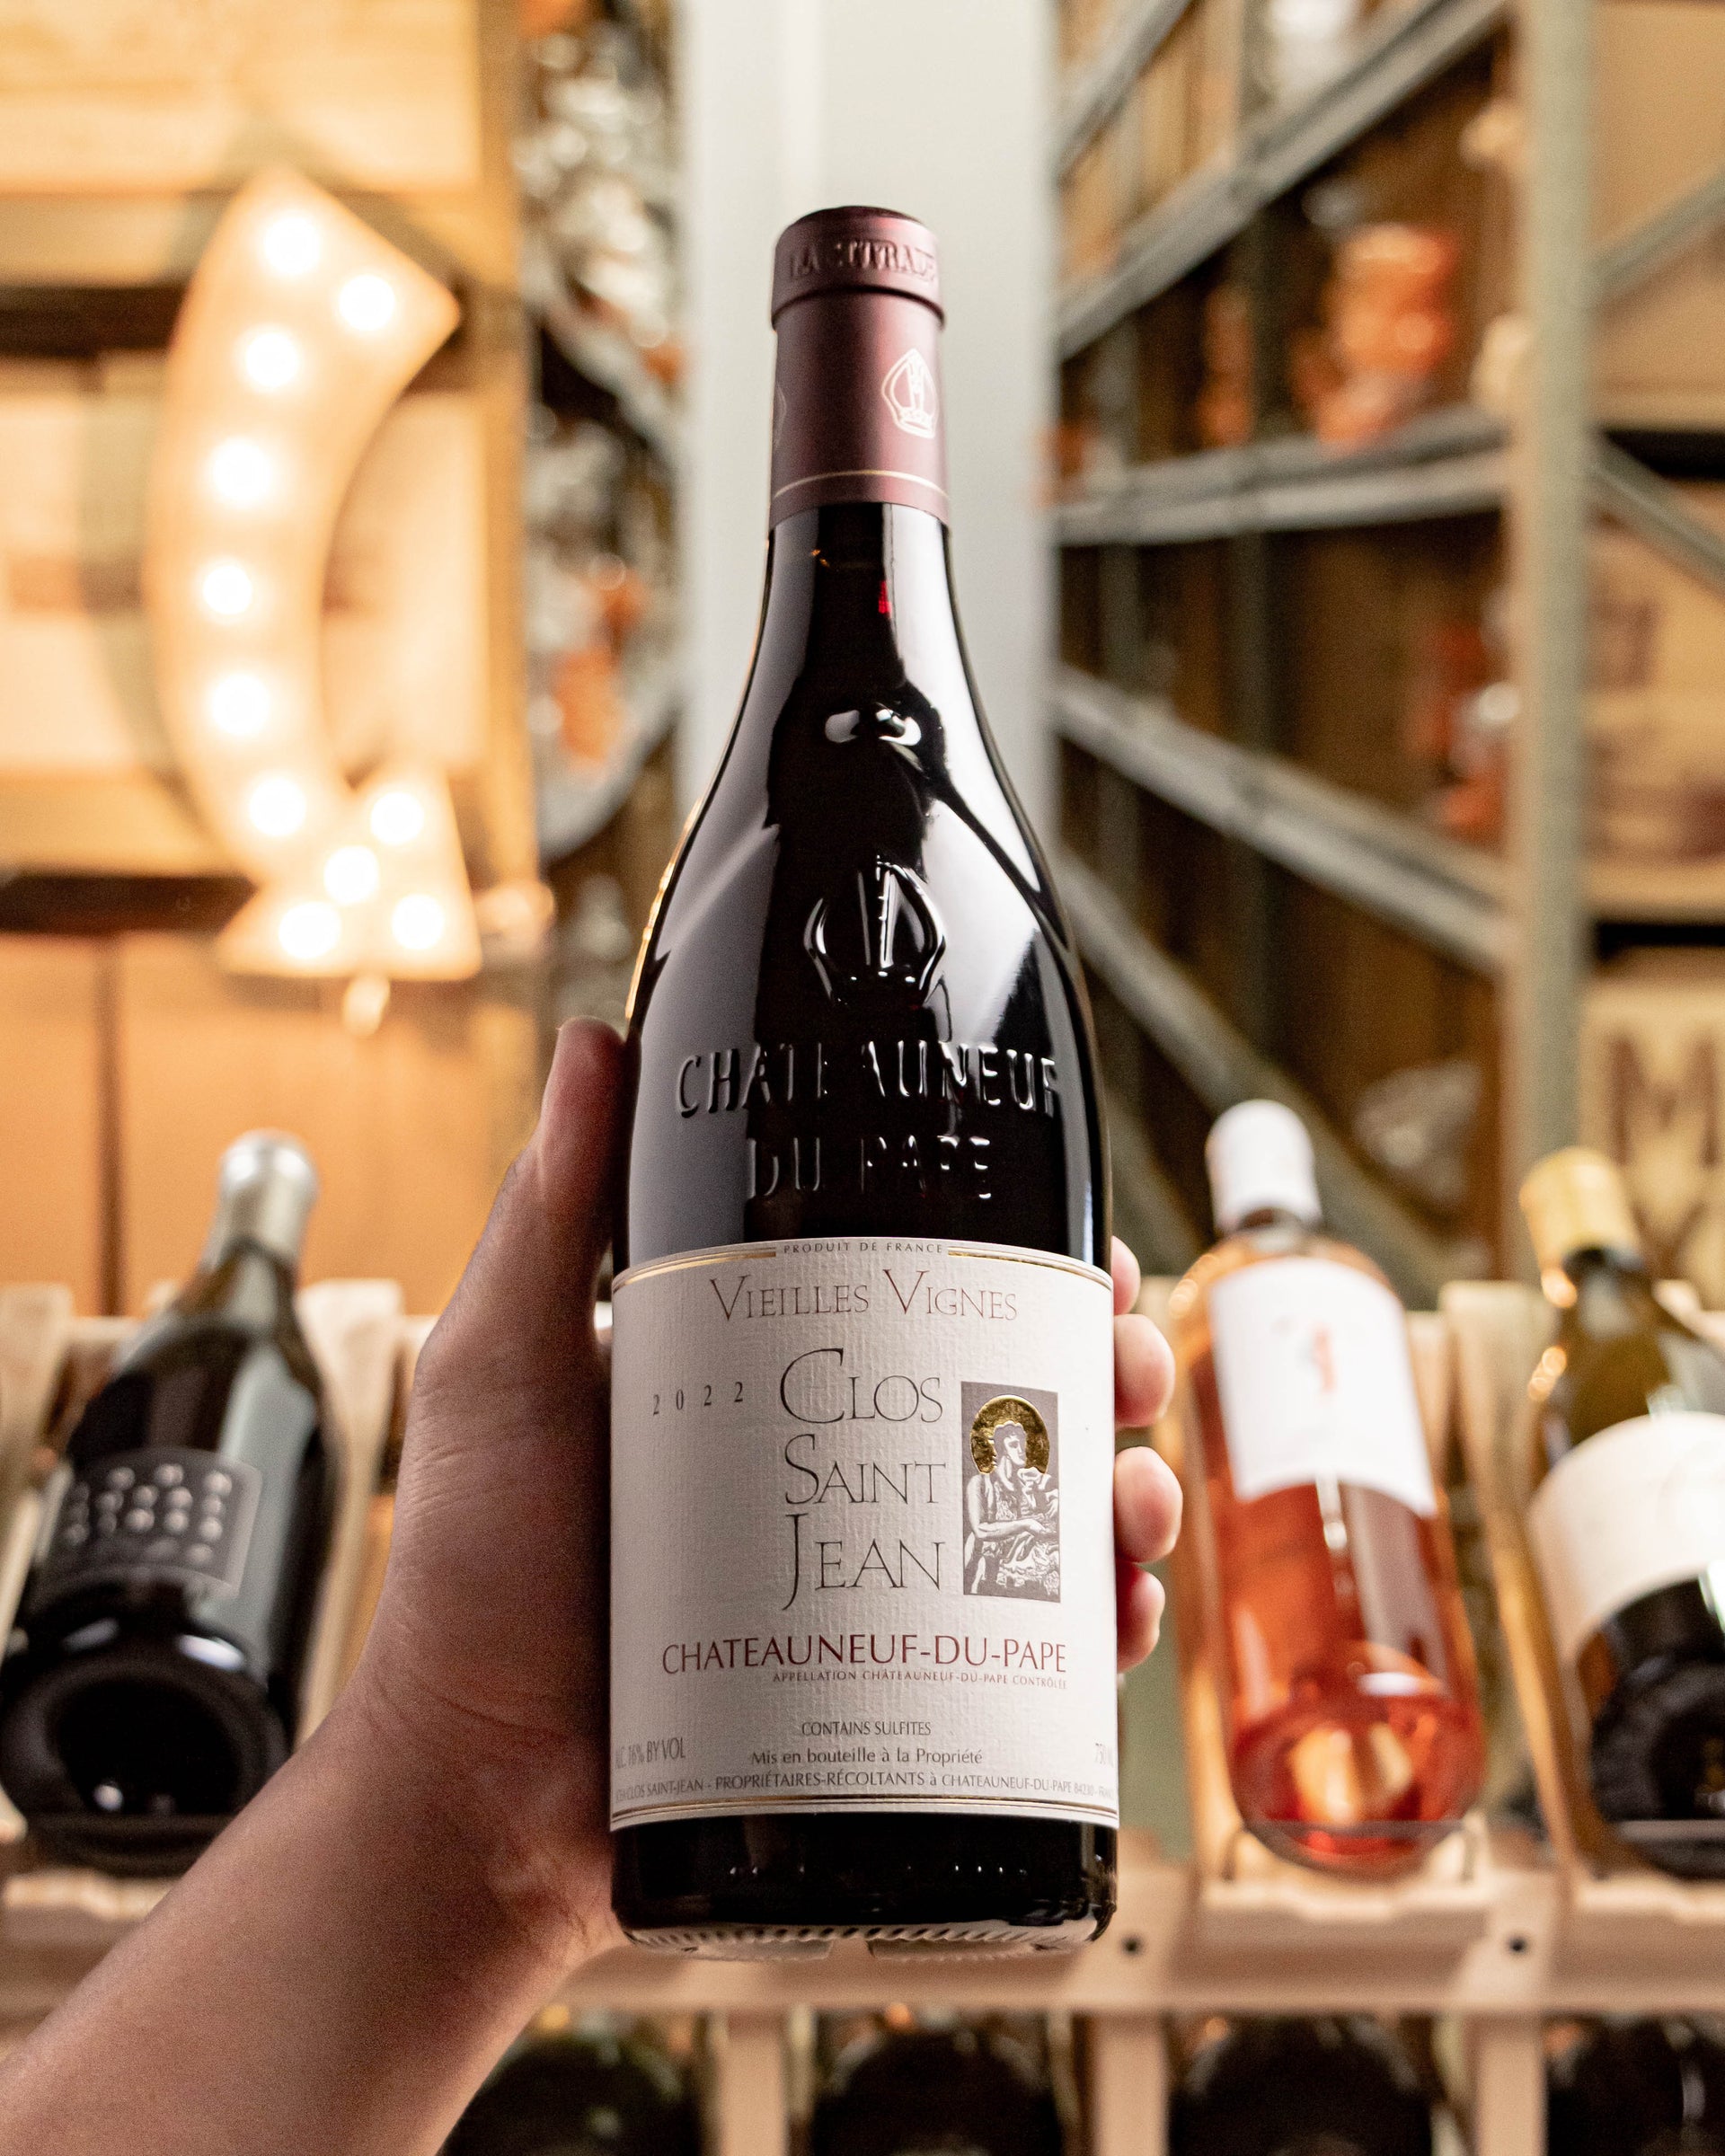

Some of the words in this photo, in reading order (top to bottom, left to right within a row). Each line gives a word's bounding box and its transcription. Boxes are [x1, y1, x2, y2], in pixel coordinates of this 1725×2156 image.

[748, 1135, 821, 1200] DU
[859, 1134, 994, 1200] PAPE
[783, 1241, 851, 1254] PRODUIT
[859, 1241, 878, 1252] DE
[886, 1241, 942, 1254] FRANCE
[709, 1273, 871, 1322] VIEILLES
[882, 1268, 1019, 1321] VIGNES
[652, 1381, 745, 1416] 2022
[779, 1348, 944, 1425] CLOS
[783, 1433, 947, 1506] SAINT
[781, 1512, 947, 1612] JEAN
[661, 1632, 1067, 1674] CHATEAUNEUF-DU-PAPE
[772, 1670, 857, 1683] APPELLATION
[801, 1720, 871, 1736] CONTAINS
[874, 1720, 933, 1736] SULFITES
[646, 1738, 660, 1763] BY
[661, 1736, 686, 1761] VOL
[751, 1750, 778, 1764] Mis
[783, 1752, 801, 1763] en
[807, 1746, 876, 1763] bouteille
[881, 1746, 890, 1763] à
[897, 1746, 910, 1763] la
[916, 1747, 983, 1768] Propriété
[646, 1778, 704, 1798] SAINT-JEAN
[715, 1768, 925, 1790] PROPRIÉTAIRES-RÉCOLTANTS
[929, 1772, 937, 1786] à
[942, 1773, 1073, 1794] CHATEAUNEUF-DU-PAPE
